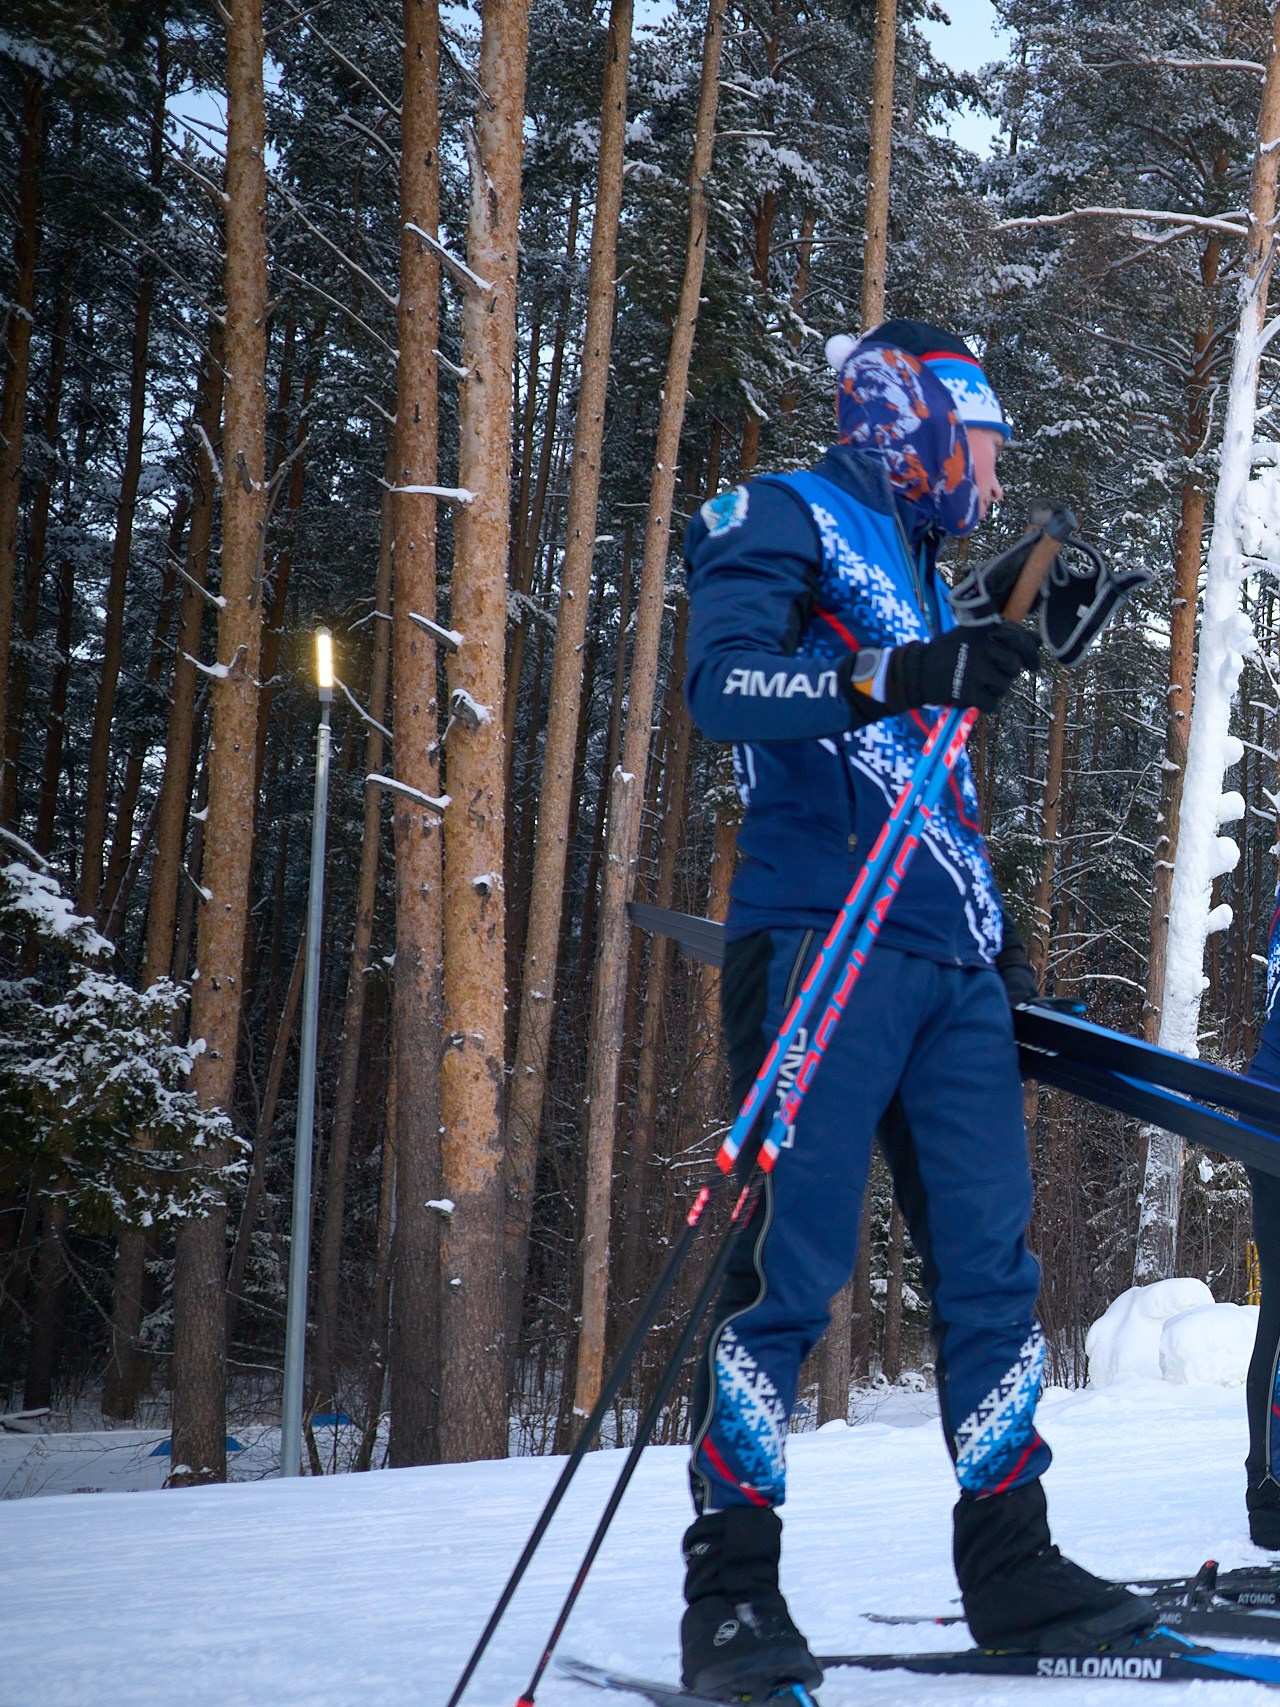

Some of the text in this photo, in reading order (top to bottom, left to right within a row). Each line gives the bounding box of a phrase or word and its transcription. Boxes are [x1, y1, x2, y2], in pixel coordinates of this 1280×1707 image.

[722, 668, 838, 699] ЯМАЛ
[1237, 1592, 1276, 1606] ATOMIC
[1036, 1656, 1163, 1679] SALOMON
